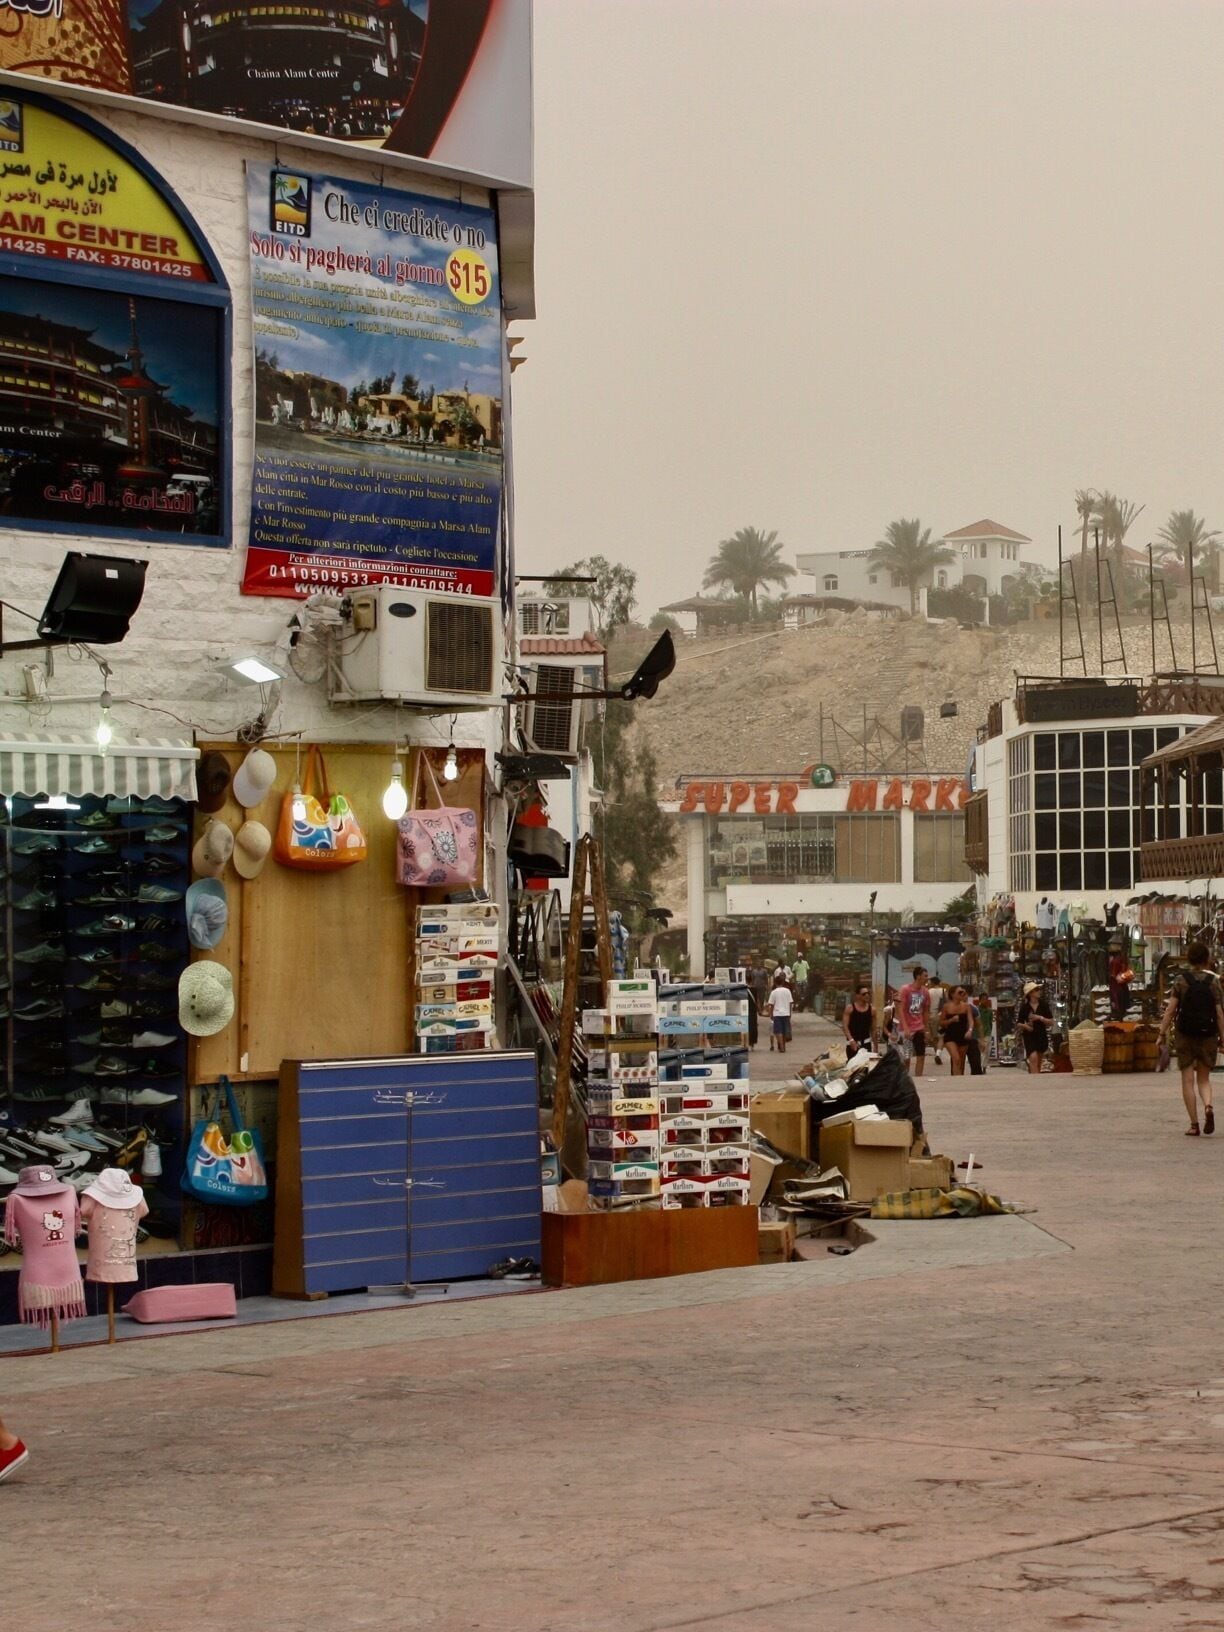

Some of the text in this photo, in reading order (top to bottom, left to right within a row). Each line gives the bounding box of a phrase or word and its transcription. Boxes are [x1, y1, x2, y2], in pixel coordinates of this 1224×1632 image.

[247, 68, 340, 79] Chaina Alam Center
[59, 163, 85, 190] مرة
[87, 169, 118, 196] لأول
[275, 220, 306, 236] EITD
[324, 192, 486, 249] Che ci crediate o no
[56, 220, 180, 257] CENTER
[67, 247, 105, 264] FAX:
[111, 254, 192, 278] 37801425
[251, 231, 445, 287] Solo si pagherà al giorno
[449, 256, 488, 297] $15
[19, 426, 62, 439] Center
[255, 468, 278, 481] Alam
[301, 473, 309, 485] in
[310, 474, 327, 487] Mar
[329, 478, 354, 491] Rosso
[355, 484, 372, 493] con
[374, 481, 381, 494] il
[383, 484, 407, 496] costo
[426, 488, 450, 501] basso
[475, 493, 493, 505] alto
[329, 462, 357, 476] partner
[360, 464, 374, 477] del
[393, 471, 424, 483] grande
[427, 472, 448, 486] hotel
[457, 477, 485, 489] Marsa
[122, 485, 195, 514] الفخامة
[255, 483, 276, 496] delle
[257, 499, 276, 511] Con
[332, 509, 348, 522] più
[349, 512, 380, 524] grande
[382, 516, 430, 531] compagnia
[440, 519, 466, 532] Marsa
[468, 522, 491, 535] Alam
[263, 515, 280, 527] Mar
[281, 517, 306, 529] Rosso
[254, 529, 284, 543] Questa
[286, 533, 312, 546] offerta
[313, 538, 330, 548] non
[353, 541, 387, 554] ripetuto
[395, 544, 432, 559] Cogliete
[434, 547, 479, 563] l'occasione
[269, 564, 369, 586] 0110509533
[382, 575, 473, 595] 0110509544
[289, 553, 458, 579] Per ulteriori informazioni contattare:
[680, 779, 799, 815] SUPER
[423, 1008, 446, 1017] CAMEL
[459, 1003, 480, 1013] CAMEL
[663, 1020, 687, 1028] CAMEL
[708, 1019, 731, 1027] CAMEL
[615, 1101, 644, 1112] CAMEL
[206, 1178, 237, 1194] Colors
